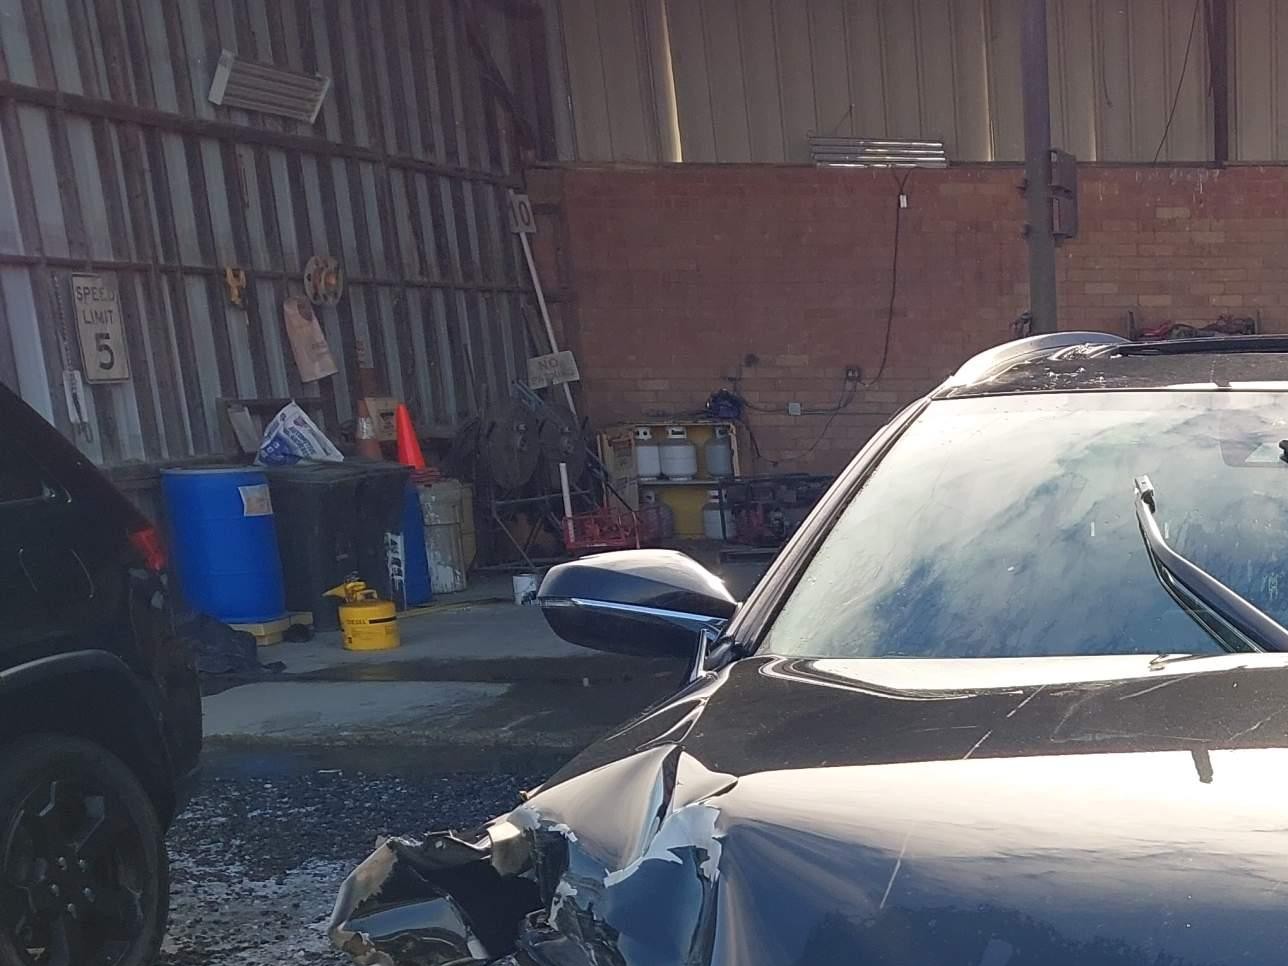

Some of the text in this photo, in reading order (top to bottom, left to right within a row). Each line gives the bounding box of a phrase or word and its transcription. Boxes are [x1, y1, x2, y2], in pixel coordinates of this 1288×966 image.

[76, 286, 116, 301] SPEED
[82, 310, 114, 325] LIMIT
[95, 332, 115, 370] 5
[538, 358, 559, 371] NO
